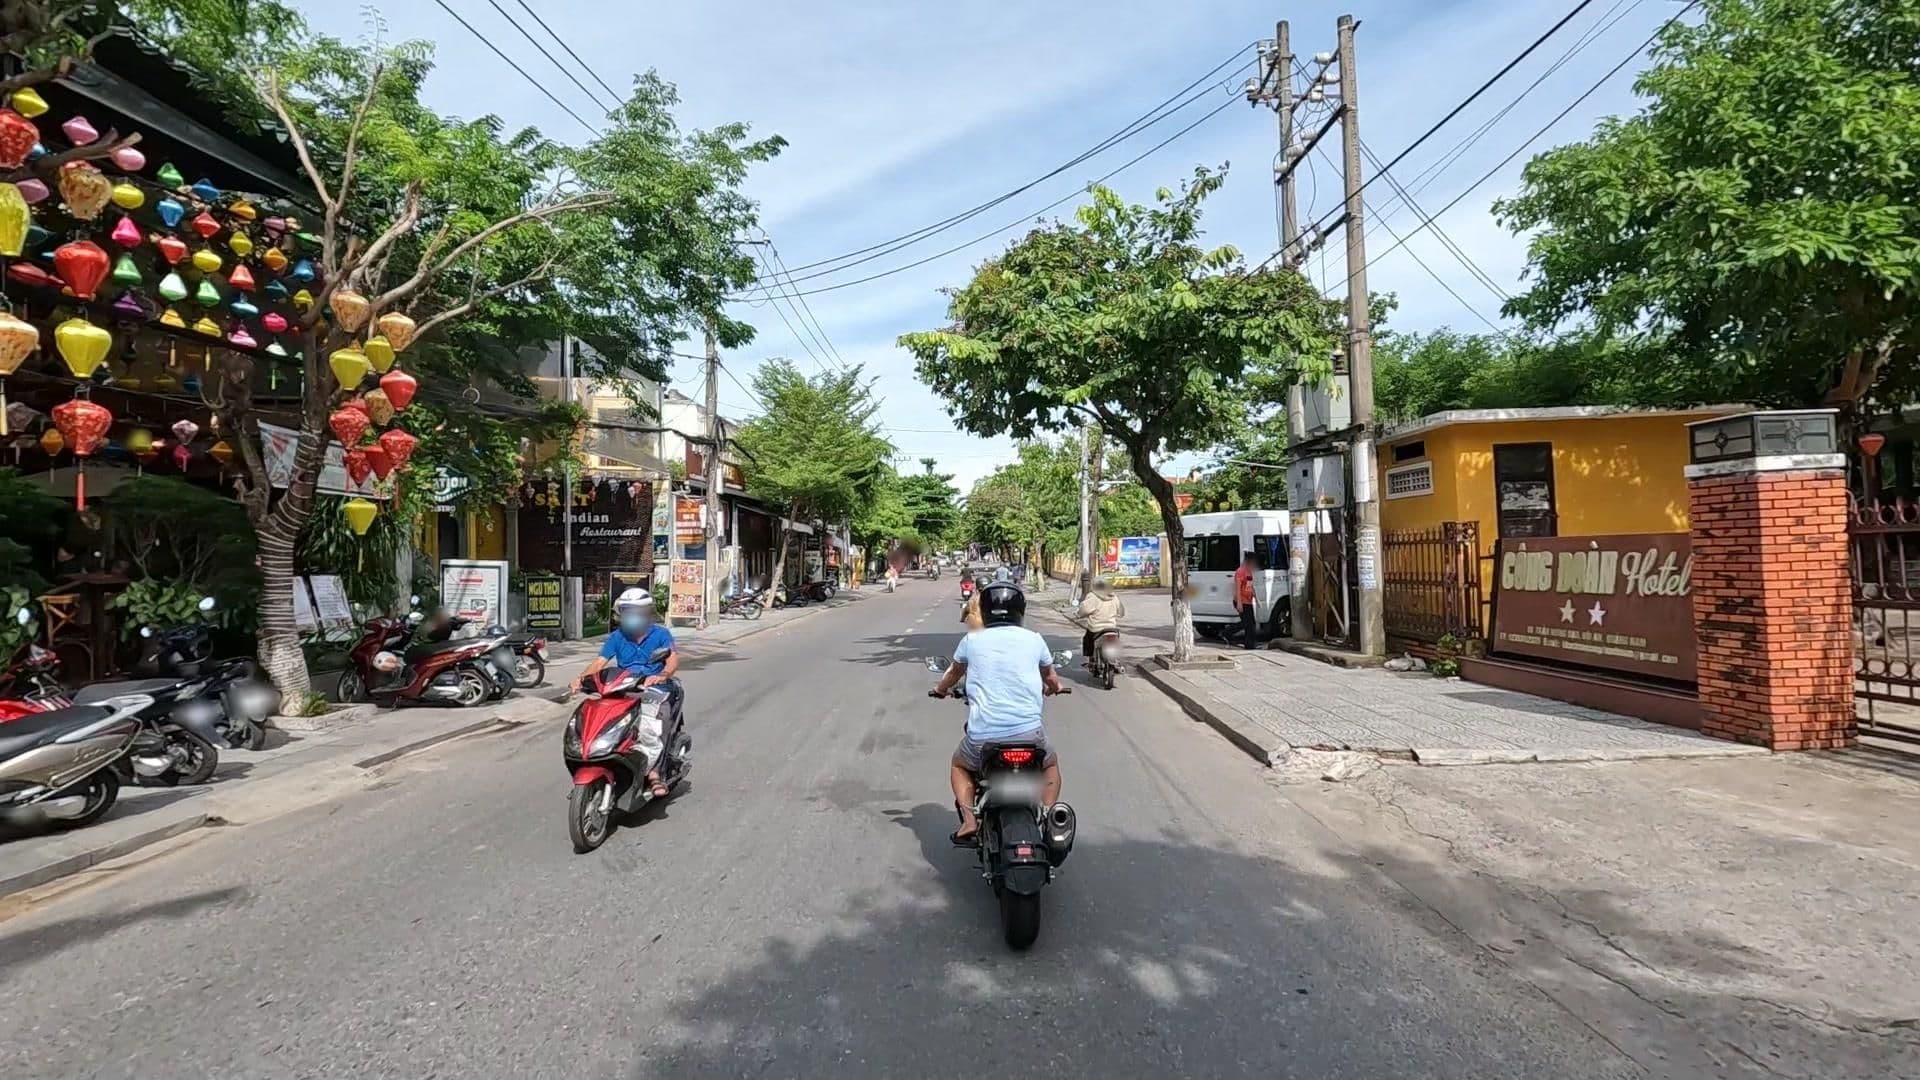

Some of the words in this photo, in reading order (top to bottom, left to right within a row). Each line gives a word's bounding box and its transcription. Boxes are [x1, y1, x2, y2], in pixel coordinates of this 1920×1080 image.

[562, 512, 609, 523] Indian
[580, 526, 642, 537] Restaurant
[1622, 548, 1694, 597] Hotel
